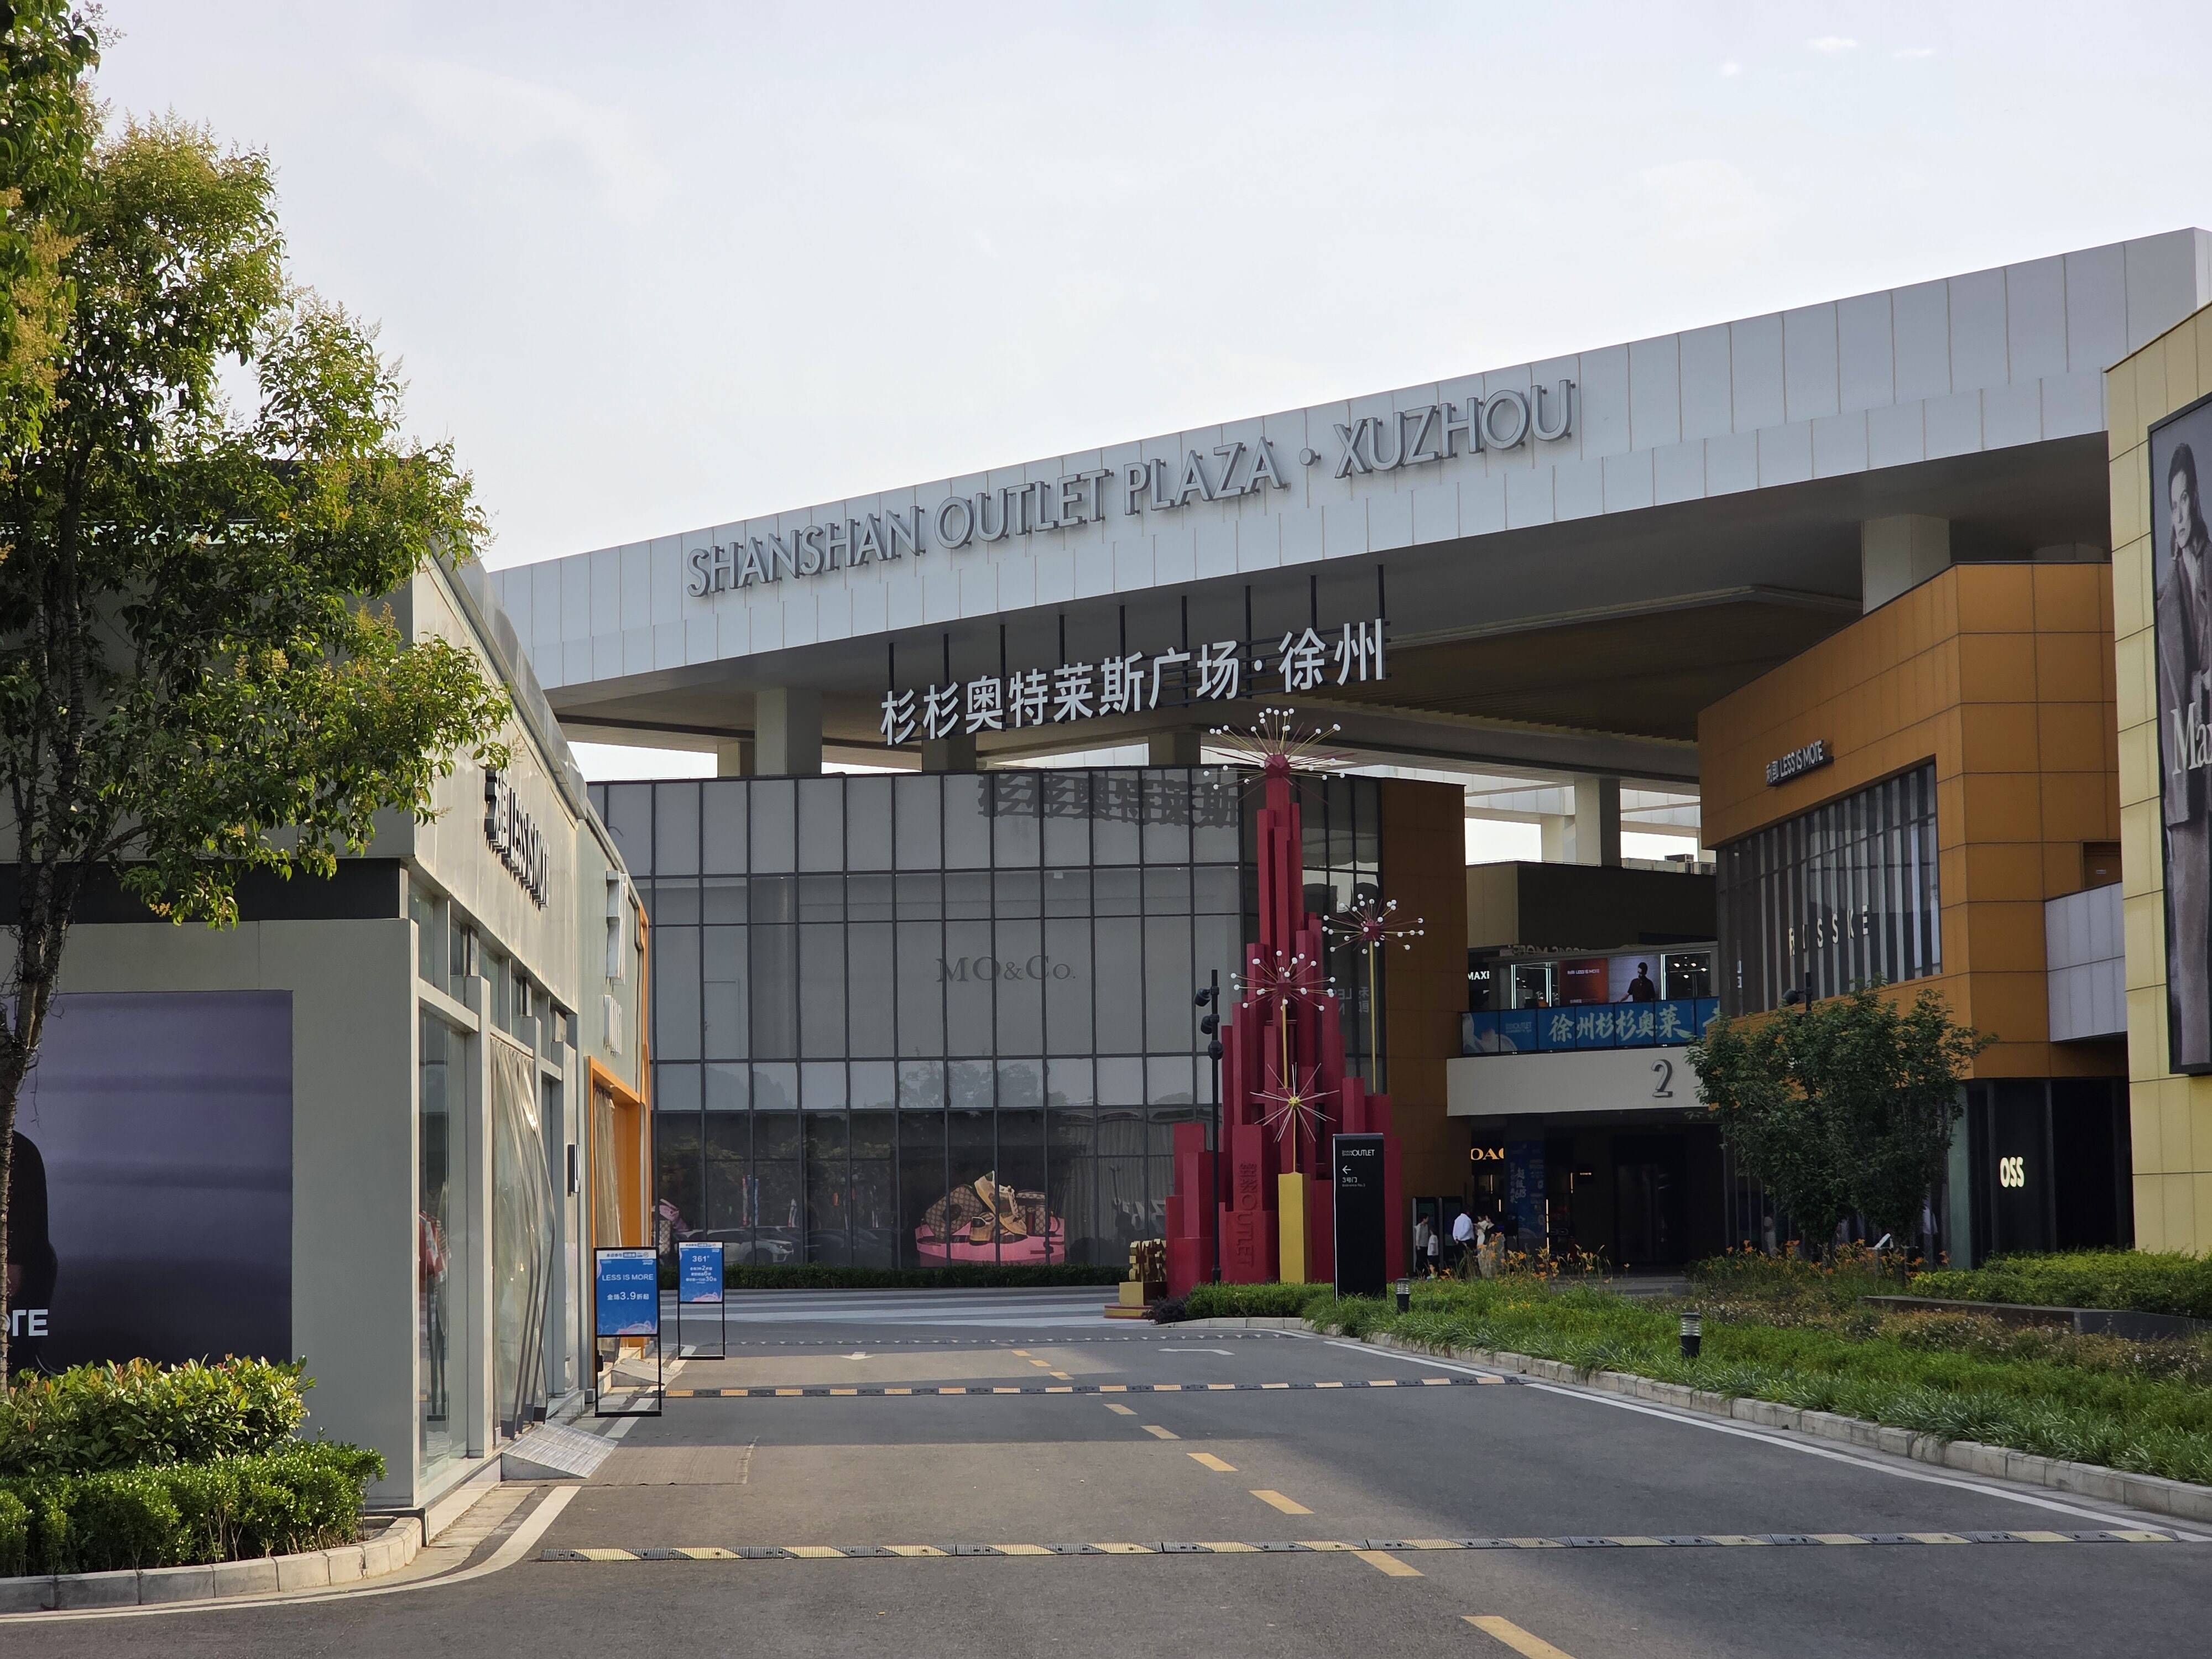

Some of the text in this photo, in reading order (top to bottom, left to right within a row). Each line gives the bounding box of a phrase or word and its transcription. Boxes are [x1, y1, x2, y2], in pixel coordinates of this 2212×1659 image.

[687, 503, 926, 597] SHANSHAN
[935, 468, 1114, 550] OUTLET
[1123, 436, 1289, 516] PLAZA
[1333, 379, 1576, 479] XUZHOU
[880, 619, 1386, 746] 杉杉奥特莱斯广场·徐州
[1780, 752, 1796, 778] LESS
[1796, 749, 1803, 770] IS
[1650, 1058, 1674, 1099] 2
[2000, 1156, 2025, 1188] OSS
